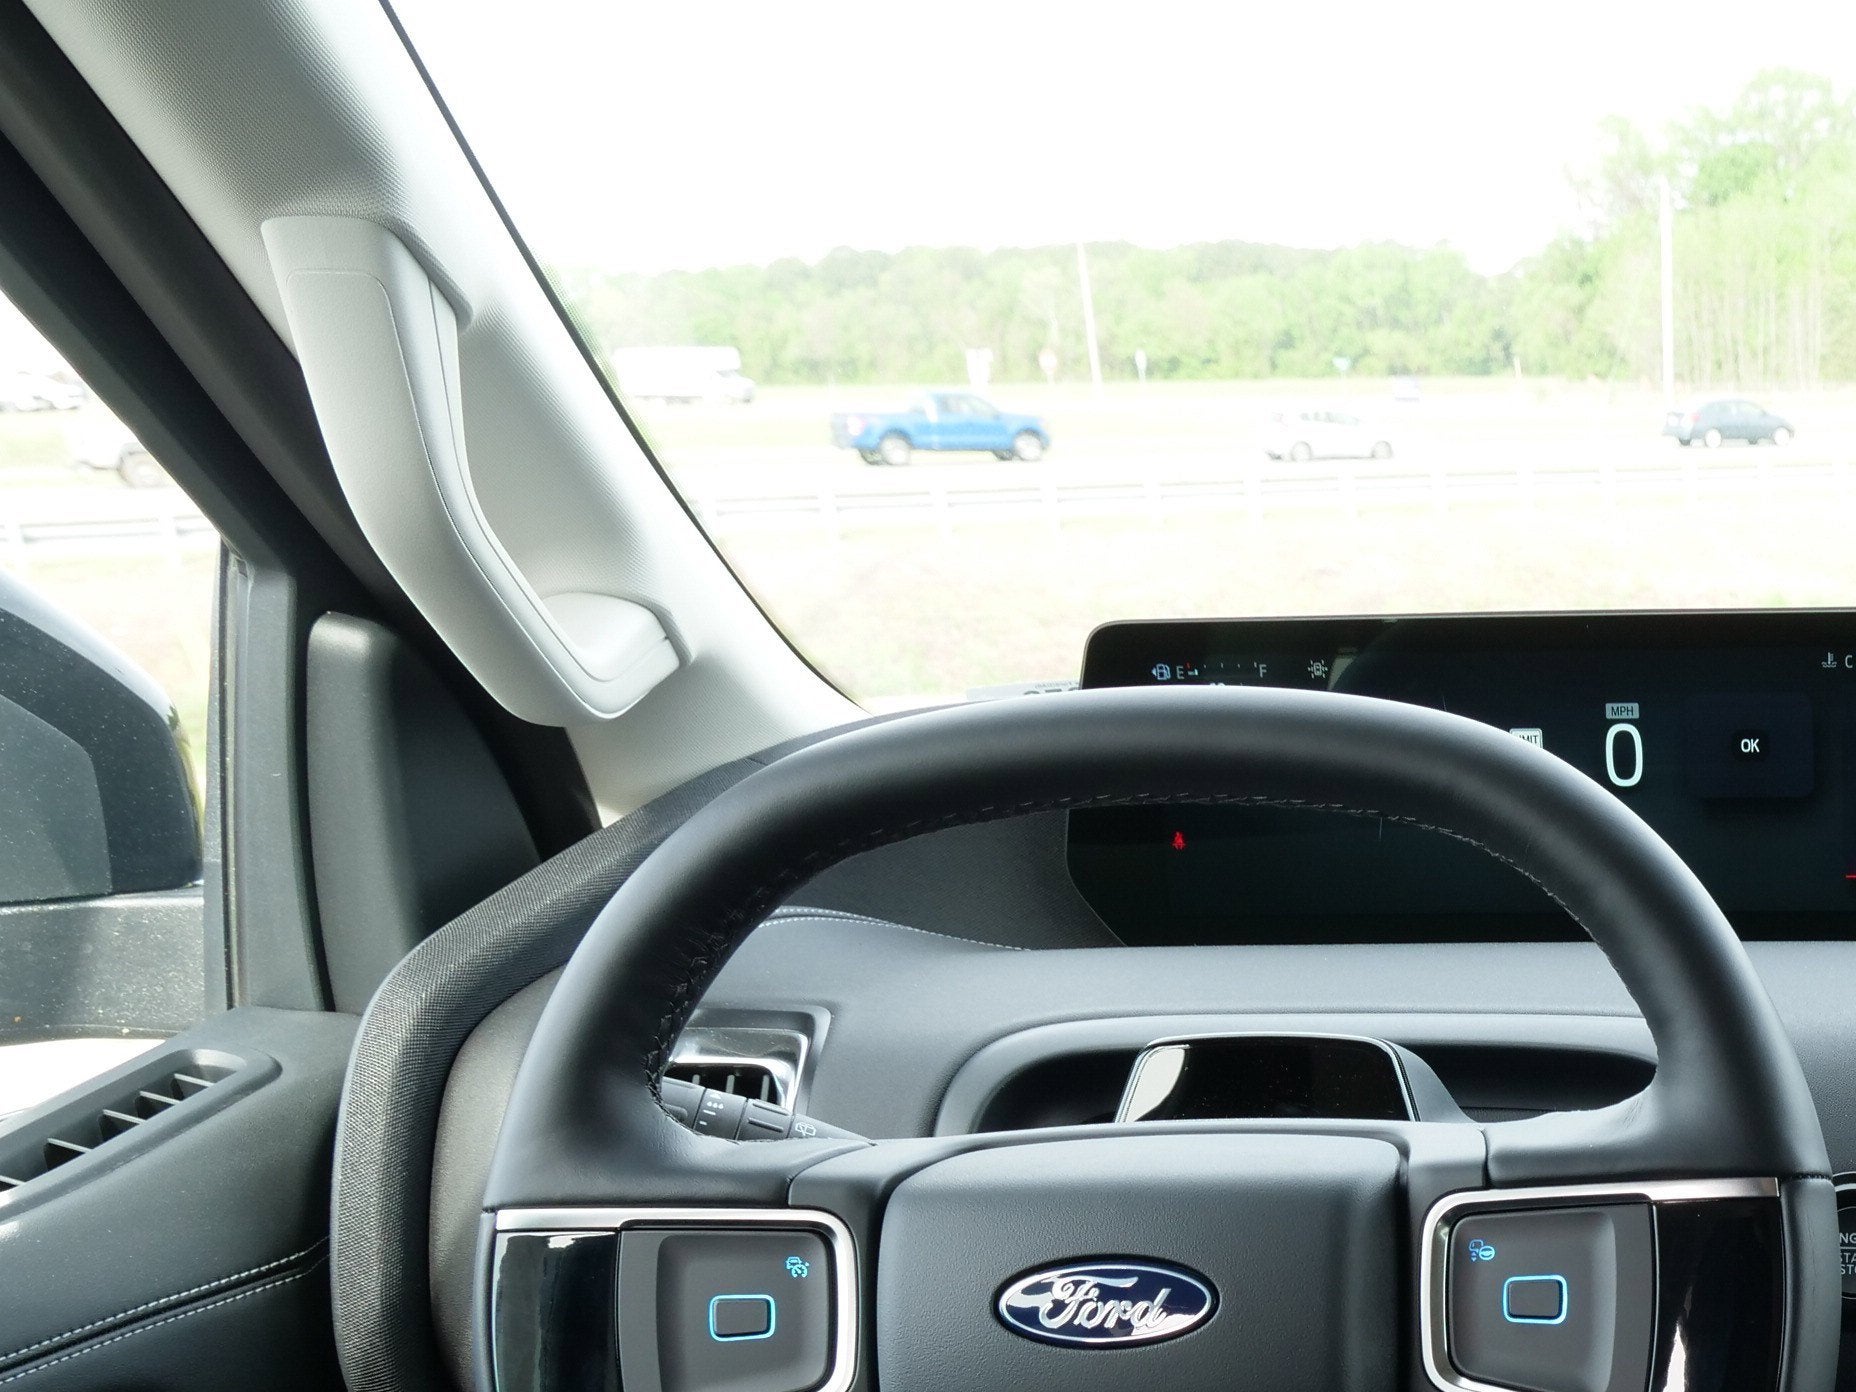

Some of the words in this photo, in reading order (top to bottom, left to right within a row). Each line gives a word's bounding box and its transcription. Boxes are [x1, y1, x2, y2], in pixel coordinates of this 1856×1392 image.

[1844, 654, 1853, 669] C
[1176, 666, 1185, 680] E
[1259, 664, 1267, 678] F
[1610, 705, 1634, 716] MPH
[1740, 738, 1760, 753] OK
[1605, 723, 1643, 787] 0
[1006, 1275, 1196, 1335] Ford
